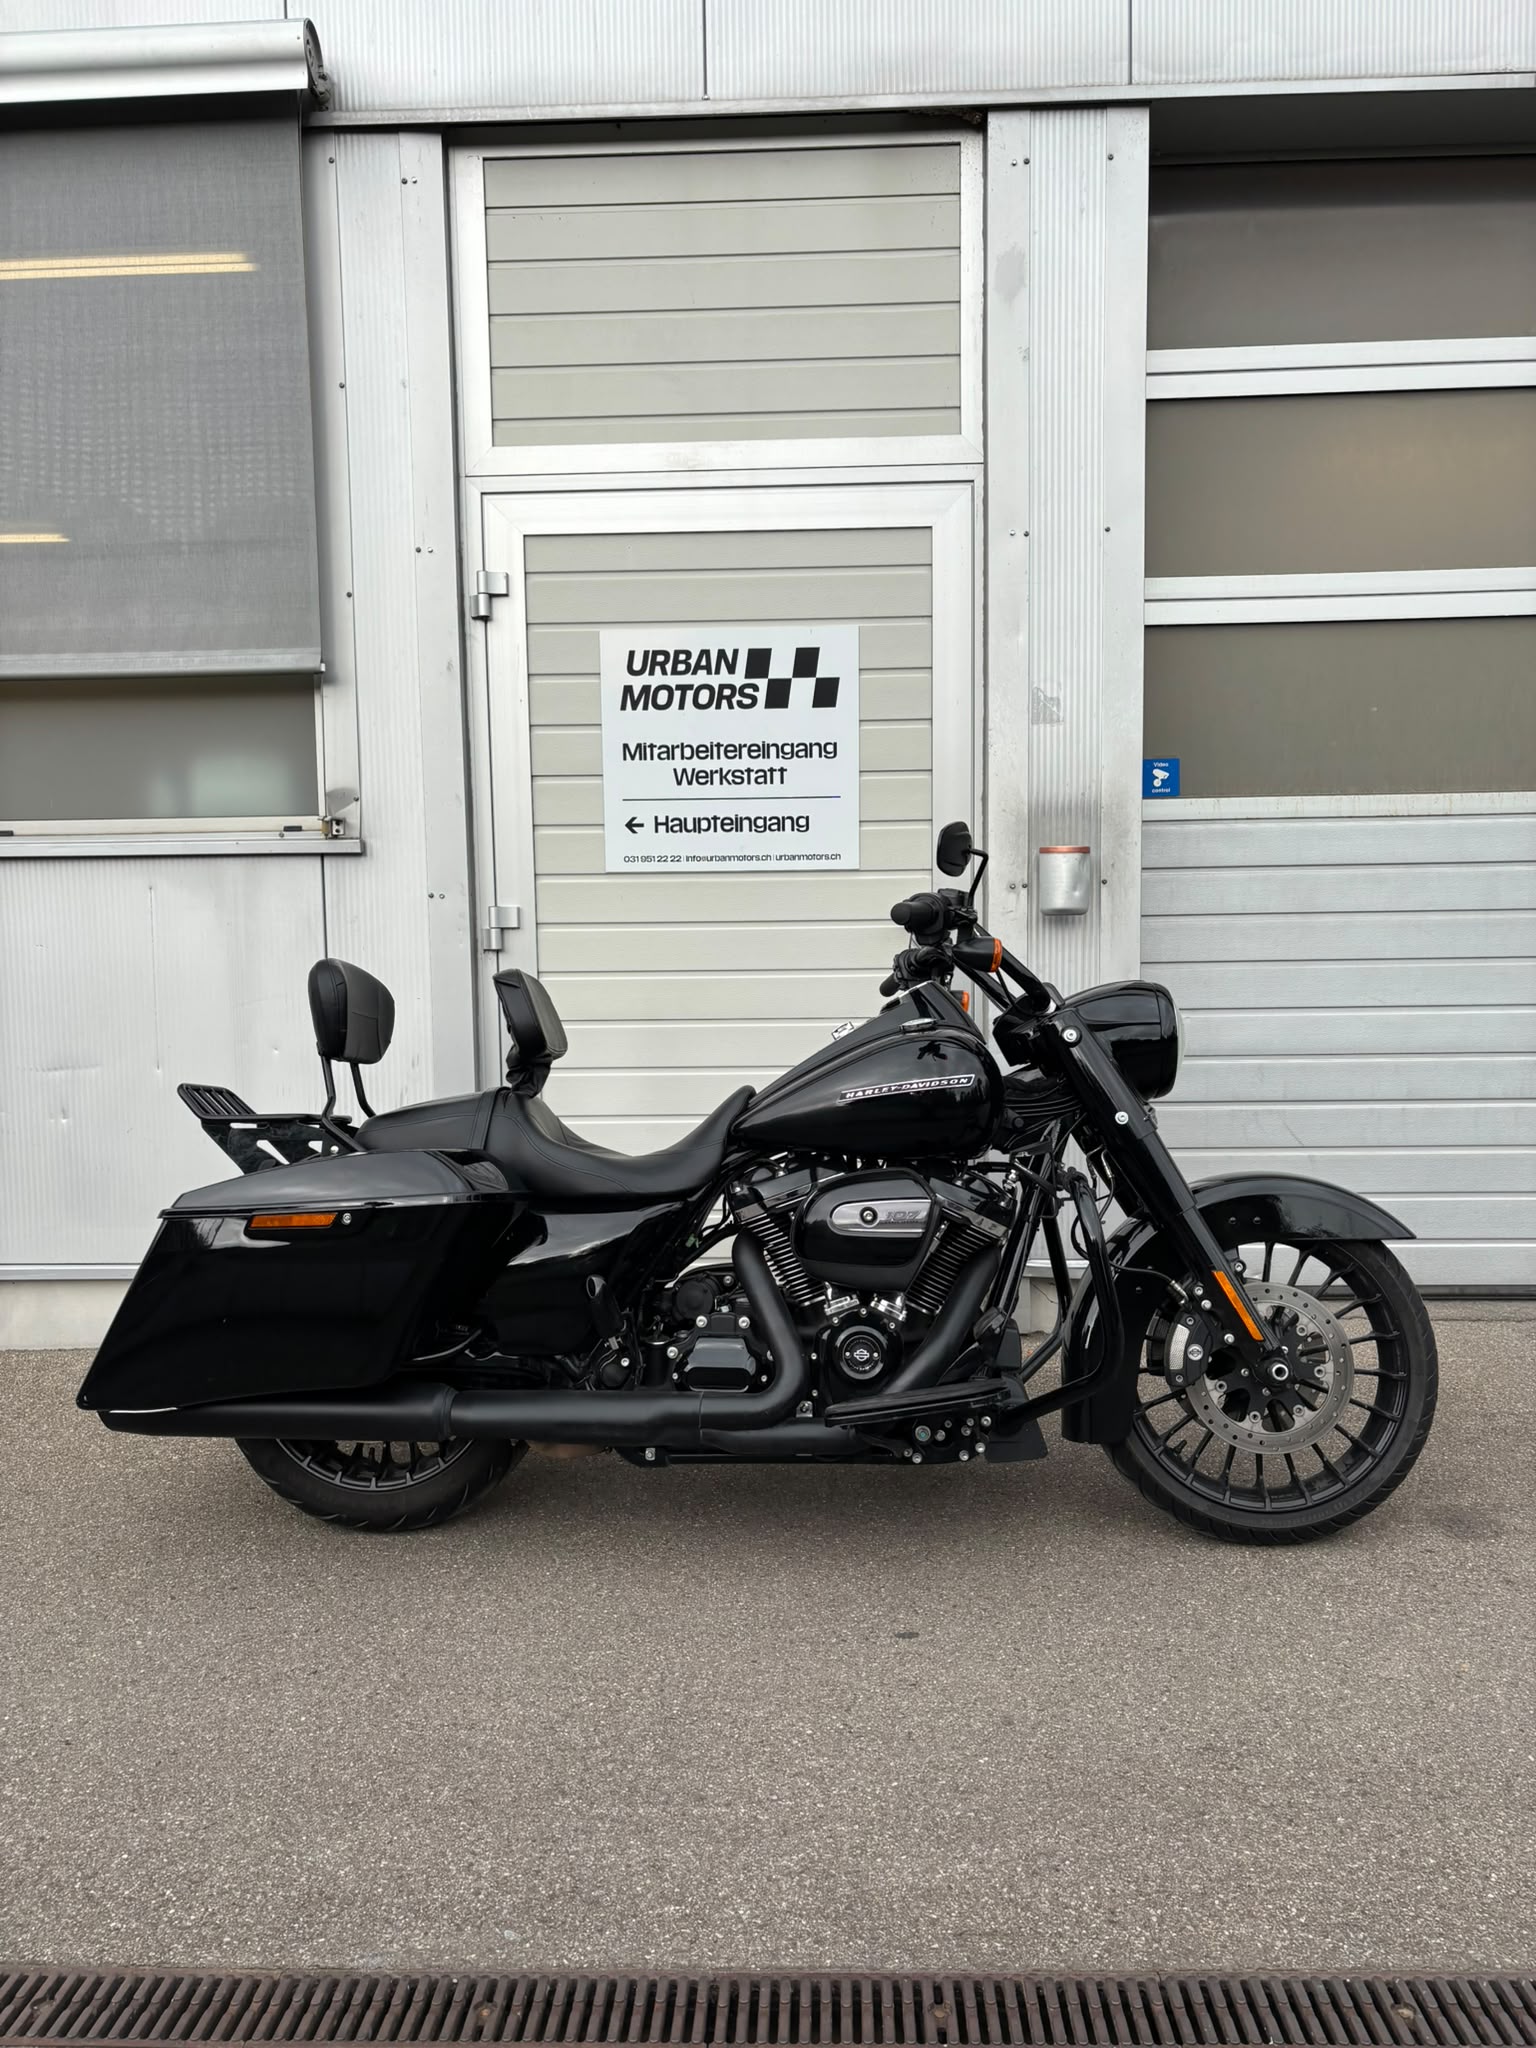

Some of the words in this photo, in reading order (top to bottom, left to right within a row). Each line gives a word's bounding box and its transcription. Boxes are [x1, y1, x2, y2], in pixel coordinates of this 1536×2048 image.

[626, 648, 740, 677] URBAN
[619, 683, 760, 711] MOTORS
[622, 740, 838, 762] Mitarbeitereingang
[673, 766, 788, 786] Werkstatt
[653, 813, 810, 834] Haupteingang
[623, 855, 639, 864] 031
[640, 855, 656, 863] 951
[656, 855, 669, 863] 22
[669, 854, 682, 863] 22
[775, 852, 842, 862] urbanmotors.ch
[845, 1078, 969, 1098] HARLEY-DAVIDSON
